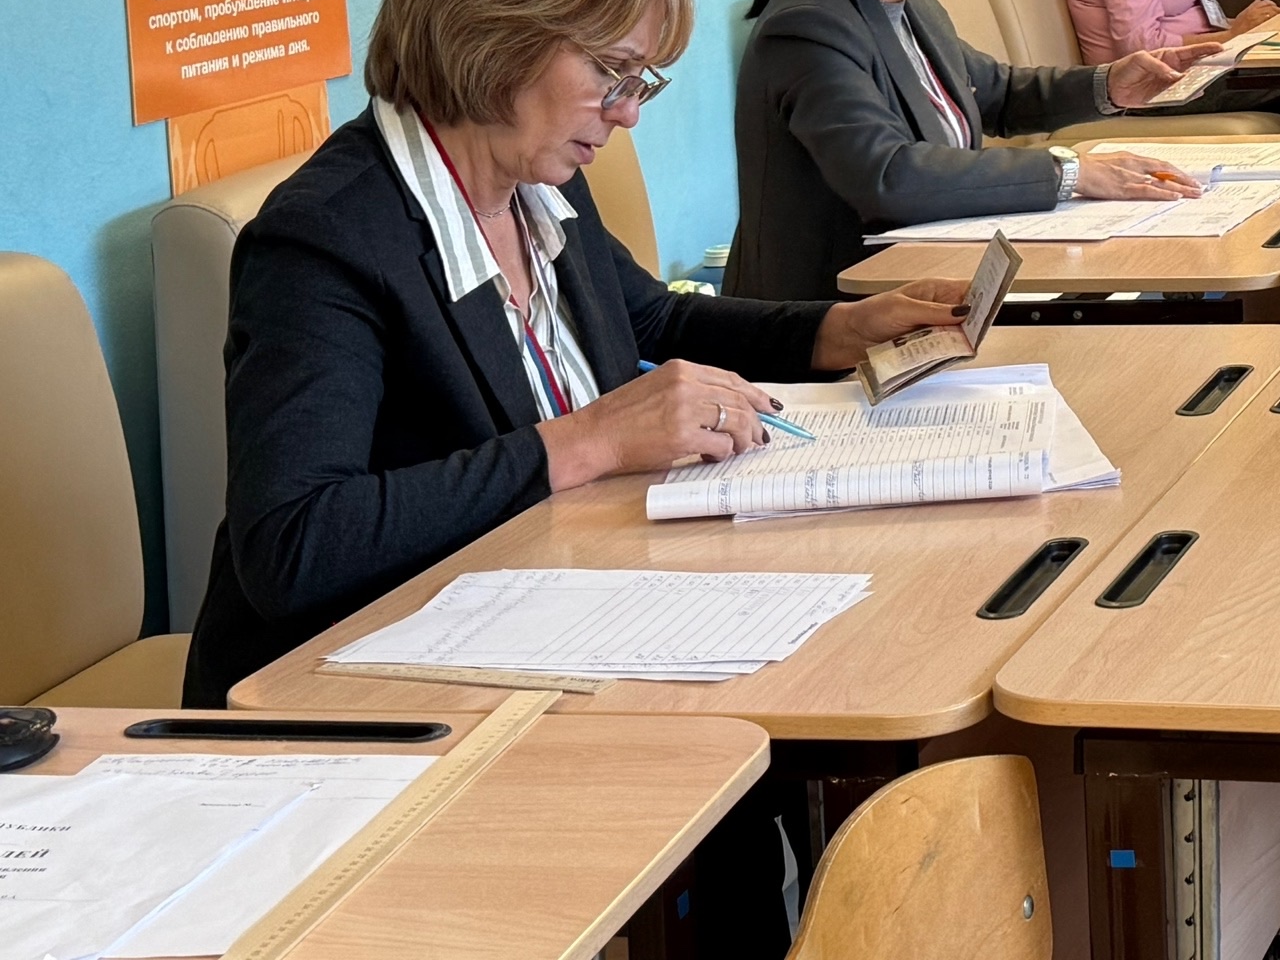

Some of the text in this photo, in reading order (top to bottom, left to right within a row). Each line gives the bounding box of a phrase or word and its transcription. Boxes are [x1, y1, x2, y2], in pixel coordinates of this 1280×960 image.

[148, 8, 202, 30] спортом,
[176, 26, 250, 52] соблюдению
[251, 10, 320, 38] правильного
[181, 37, 310, 80] питания и режима дня.
